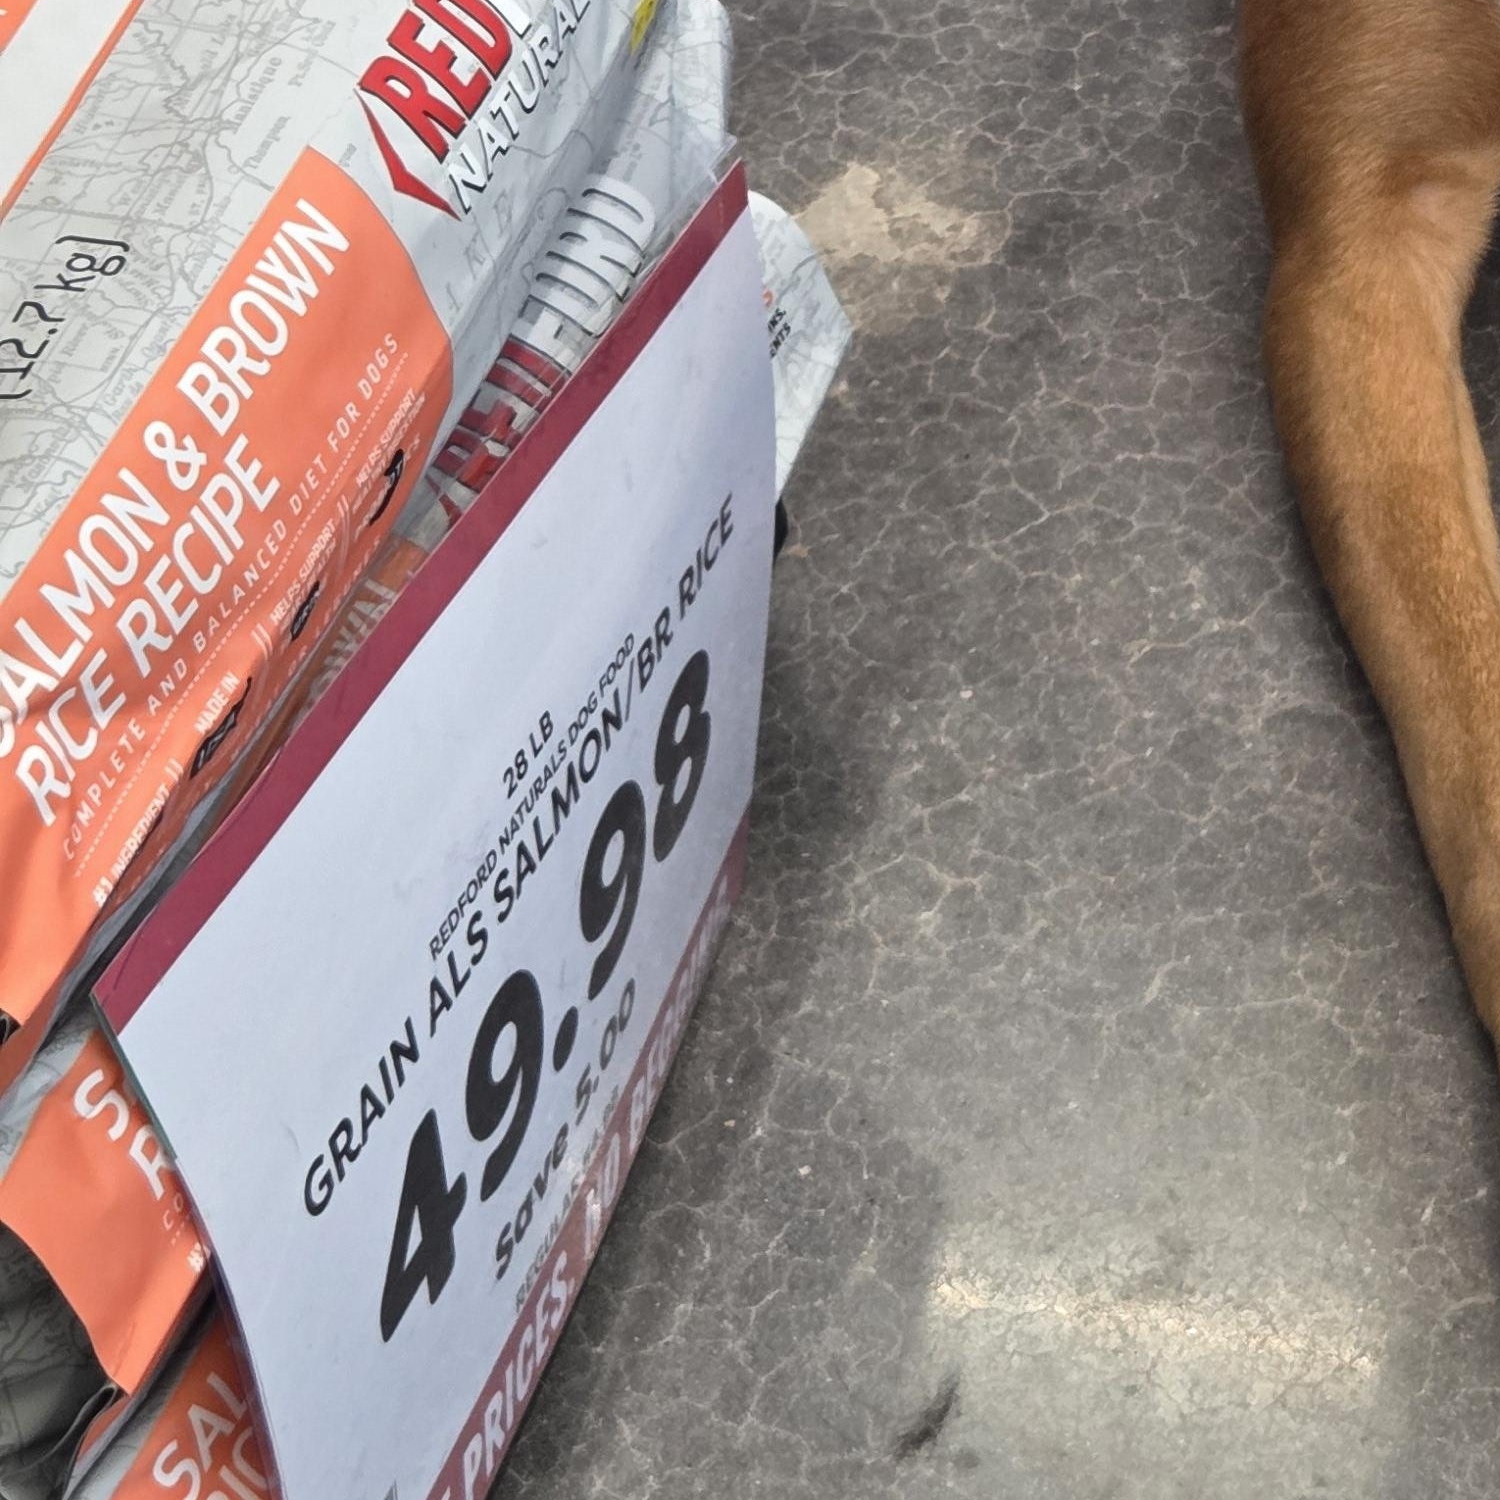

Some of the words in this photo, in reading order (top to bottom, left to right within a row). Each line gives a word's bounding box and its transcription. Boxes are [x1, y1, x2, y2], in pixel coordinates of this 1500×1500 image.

[34, 235, 130, 293] kg)
[143, 420, 207, 491] &
[176, 198, 350, 437] BROWN
[380, 387, 416, 450] SUPPORT
[16, 647, 127, 827] RICE
[117, 433, 280, 678] RECIPE
[64, 719, 146, 860] COMPLETE
[147, 658, 188, 716] AND
[193, 519, 287, 653] BALANCED
[289, 454, 328, 517] DIET
[327, 401, 360, 452] FOR
[357, 333, 398, 400] DOGS
[194, 688, 229, 736] MADE
[222, 670, 242, 695] IN
[269, 580, 301, 626] HELPS
[299, 518, 336, 583] SUPPORT
[110, 784, 171, 883] INGREDIENT
[303, 1016, 420, 1217] GRAIN
[430, 910, 488, 1038] ALS
[492, 606, 674, 926] SALMON/BR
[678, 492, 735, 621] RICE
[429, 849, 498, 960] REDFORD
[498, 739, 568, 856] NATURALS
[567, 692, 599, 746] DOG
[598, 632, 635, 699] FOOD
[502, 749, 528, 799] 28
[528, 710, 554, 757] LB
[380, 649, 711, 1343] 49.98
[495, 1122, 570, 1281] Save
[574, 977, 636, 1127] 5.00
